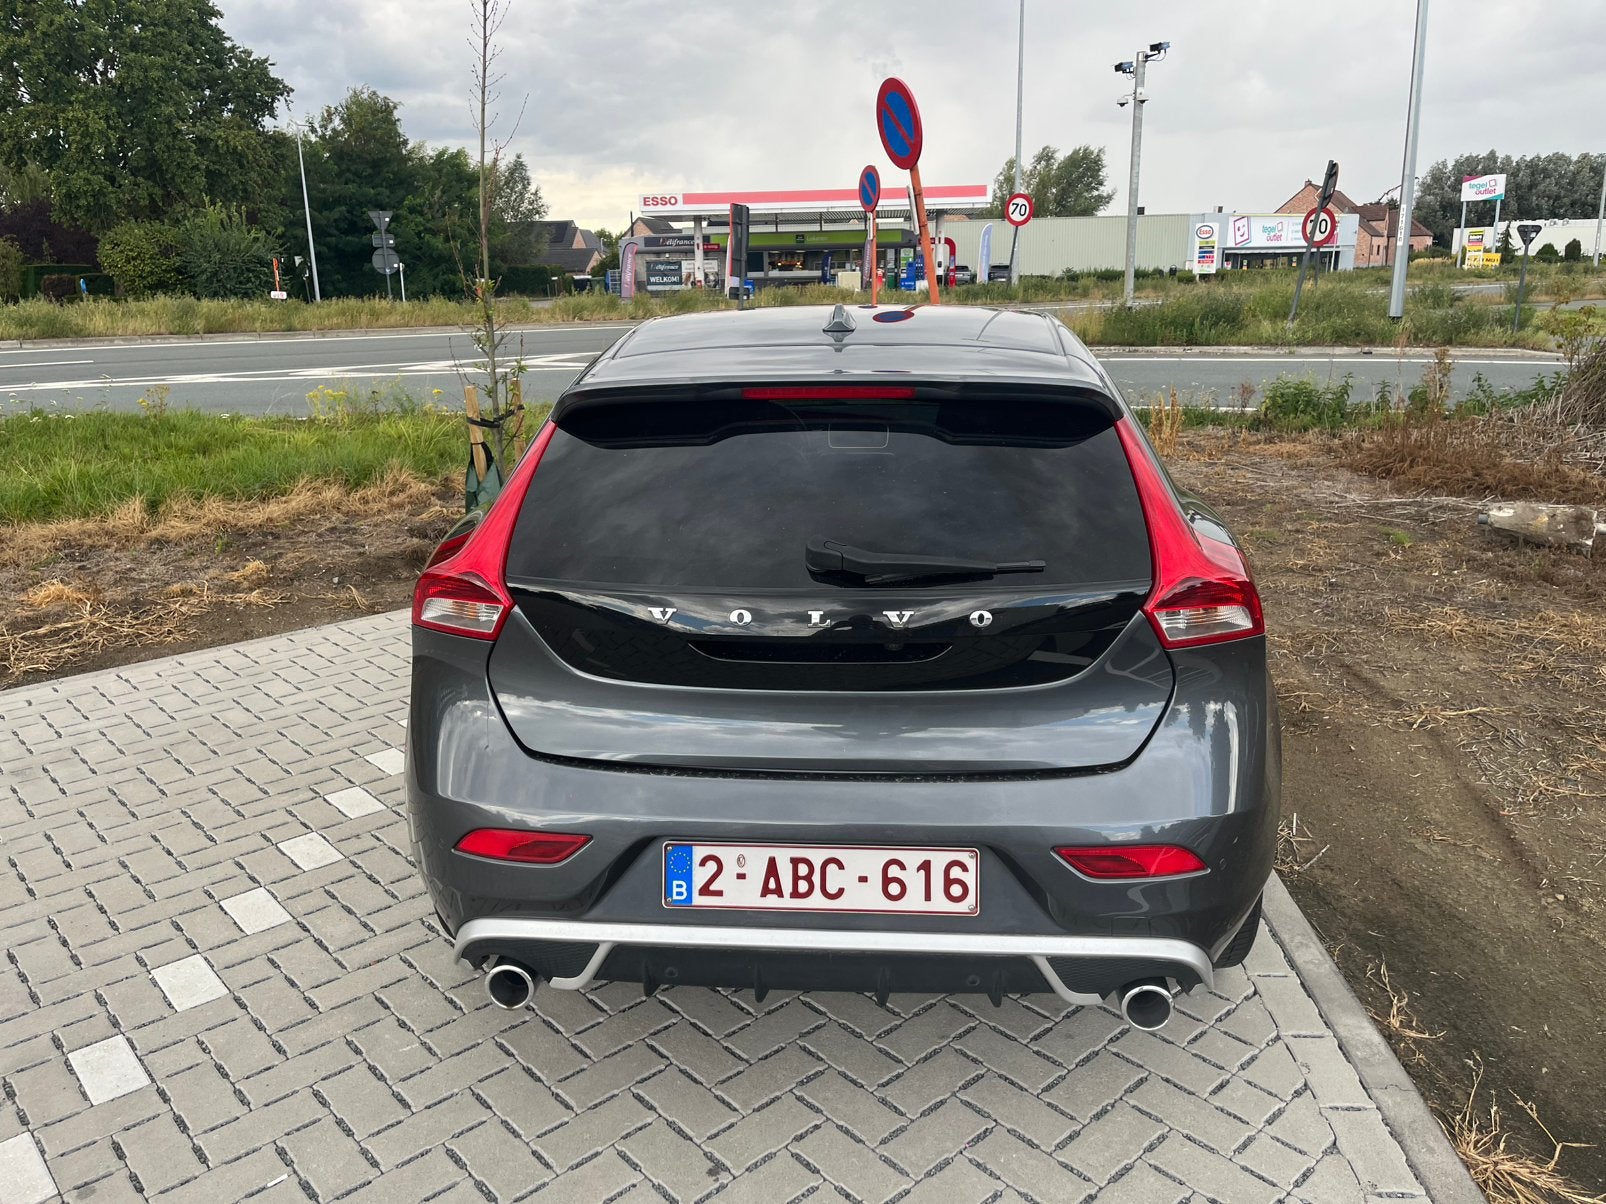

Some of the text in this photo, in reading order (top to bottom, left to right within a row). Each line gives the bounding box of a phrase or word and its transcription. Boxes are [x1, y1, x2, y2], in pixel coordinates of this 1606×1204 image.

[1469, 181, 1488, 190] tegel
[1475, 187, 1497, 196] outlet
[643, 196, 678, 207] ESSO
[1011, 203, 1027, 217] 70
[1199, 228, 1212, 236] Esso
[647, 607, 994, 629] VOLVO
[671, 880, 688, 901] B
